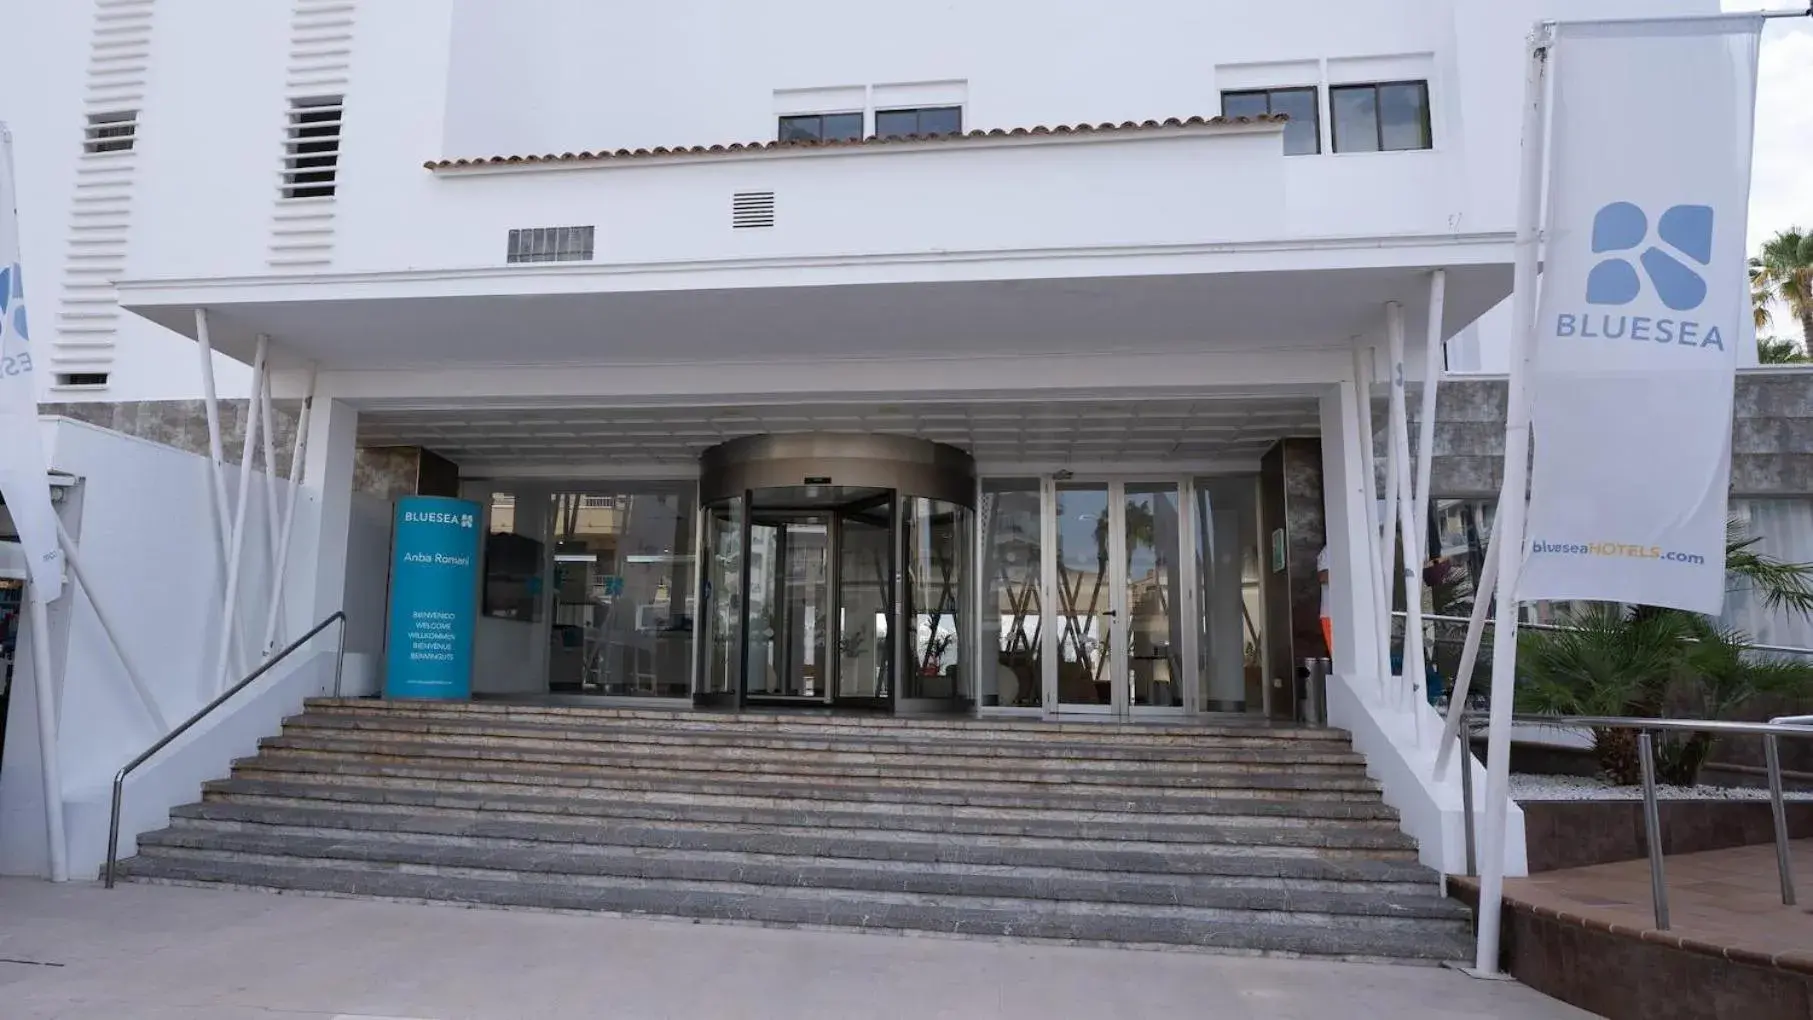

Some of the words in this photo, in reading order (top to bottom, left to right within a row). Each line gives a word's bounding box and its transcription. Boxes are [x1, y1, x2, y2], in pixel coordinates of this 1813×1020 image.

[1556, 313, 1725, 352] BLUESEA
[405, 511, 459, 524] BLUESEA
[404, 552, 432, 563] Anba
[434, 552, 470, 566] Romani
[1532, 540, 1705, 565] blueseaHOTELS.com
[415, 622, 452, 630] WELCOME
